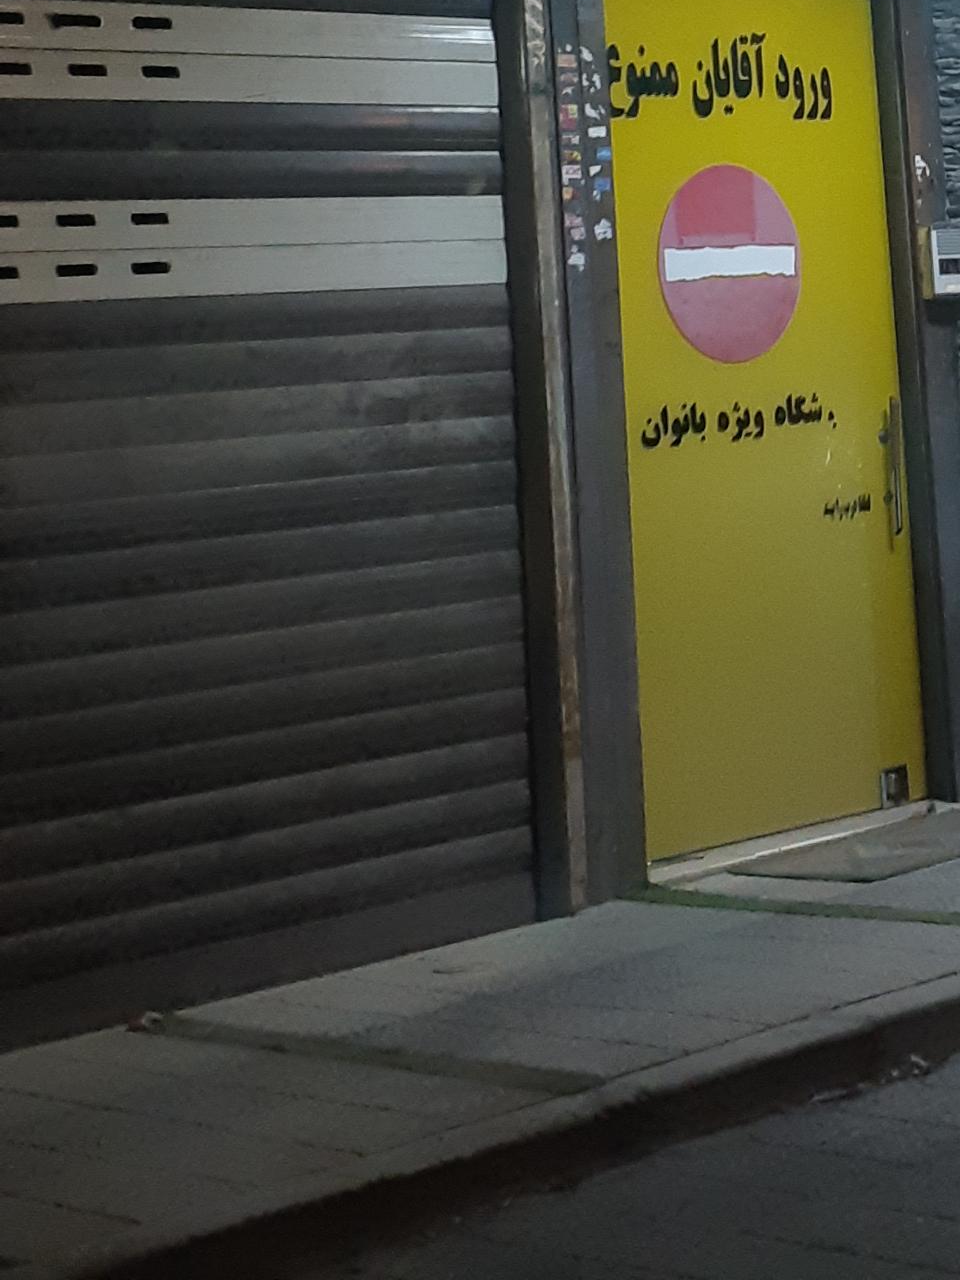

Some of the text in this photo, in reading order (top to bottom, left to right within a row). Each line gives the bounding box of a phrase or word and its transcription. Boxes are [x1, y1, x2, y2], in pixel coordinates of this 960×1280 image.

[605, 32, 833, 120] ورود آقایان ممنوع
[640, 401, 707, 448] بانوان
[716, 401, 765, 443] ویژه
